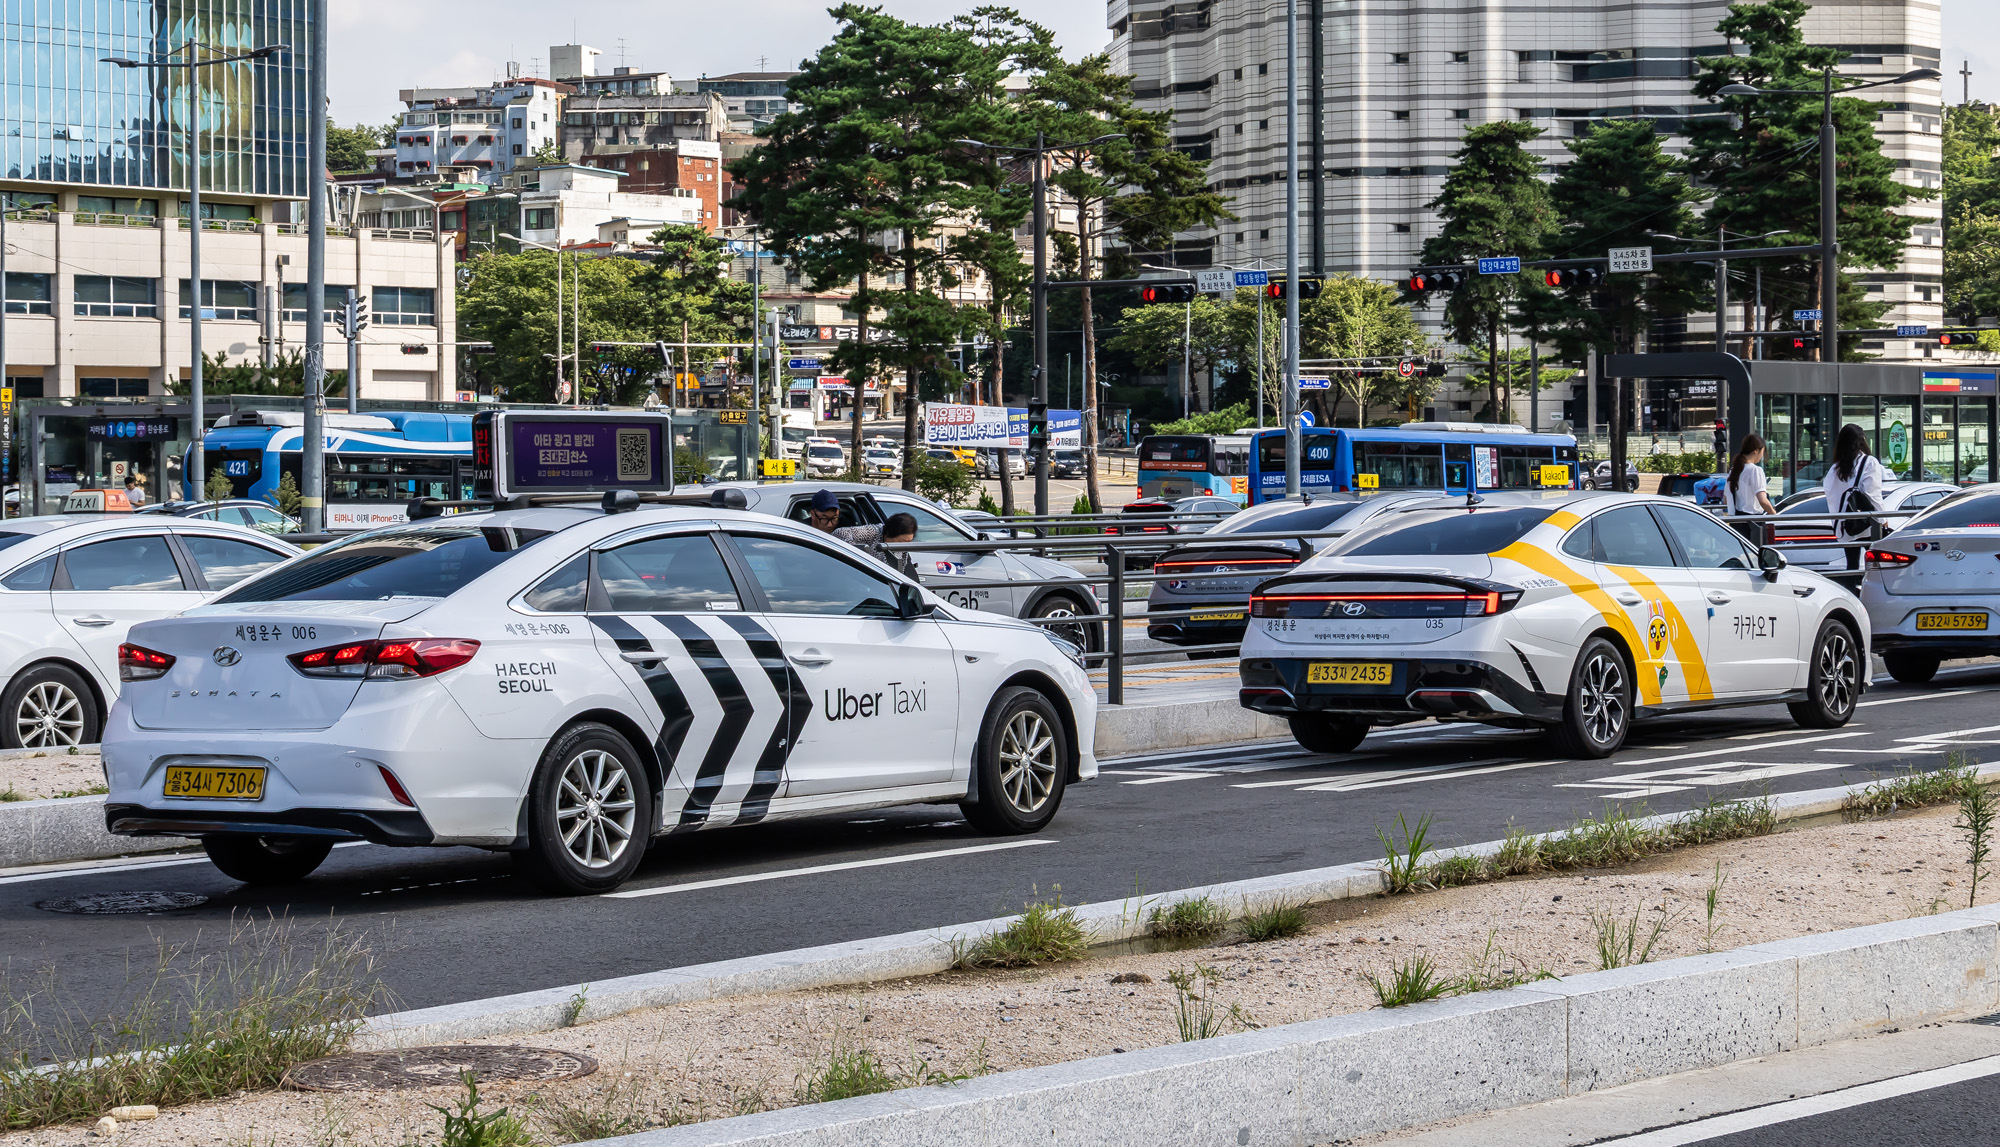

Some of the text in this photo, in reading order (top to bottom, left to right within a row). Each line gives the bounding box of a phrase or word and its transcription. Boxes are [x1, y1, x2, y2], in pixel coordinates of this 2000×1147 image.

[1481, 259, 1518, 272] 한강대교방면
[1612, 259, 1649, 270] 직진전용
[1237, 273, 1266, 284] 후암동방면
[1200, 281, 1232, 290] 좌회전전용
[1794, 310, 1822, 320] 버스전용
[782, 327, 810, 338] 노래방
[1402, 363, 1412, 372] 50
[929, 408, 975, 422] 자유통일당
[928, 422, 1006, 440] 당원이 되어주세요!
[534, 434, 594, 447] 아타 광고 발견!
[542, 450, 588, 463] 초대권 찬스
[1310, 448, 1328, 459] 400
[228, 461, 246, 474] 421
[771, 462, 788, 473] 서울
[474, 470, 492, 480] TAXI
[70, 498, 96, 508] TAXI
[356, 513, 370, 523] 이제
[370, 513, 405, 523] iPhone으로
[1266, 619, 1444, 632] 성진통운 035
[1734, 614, 1777, 640] 카카오 T
[1953, 615, 1982, 628] 5739
[236, 624, 316, 641] 세영운수 006
[495, 662, 557, 676] HAECHI
[1350, 666, 1386, 681] 2435
[498, 679, 553, 694] SEOUL
[171, 690, 281, 698] SONATA
[825, 681, 926, 721] Uber Taxi
[557, 736, 580, 760] KUMHO
[216, 772, 256, 794] 7306
